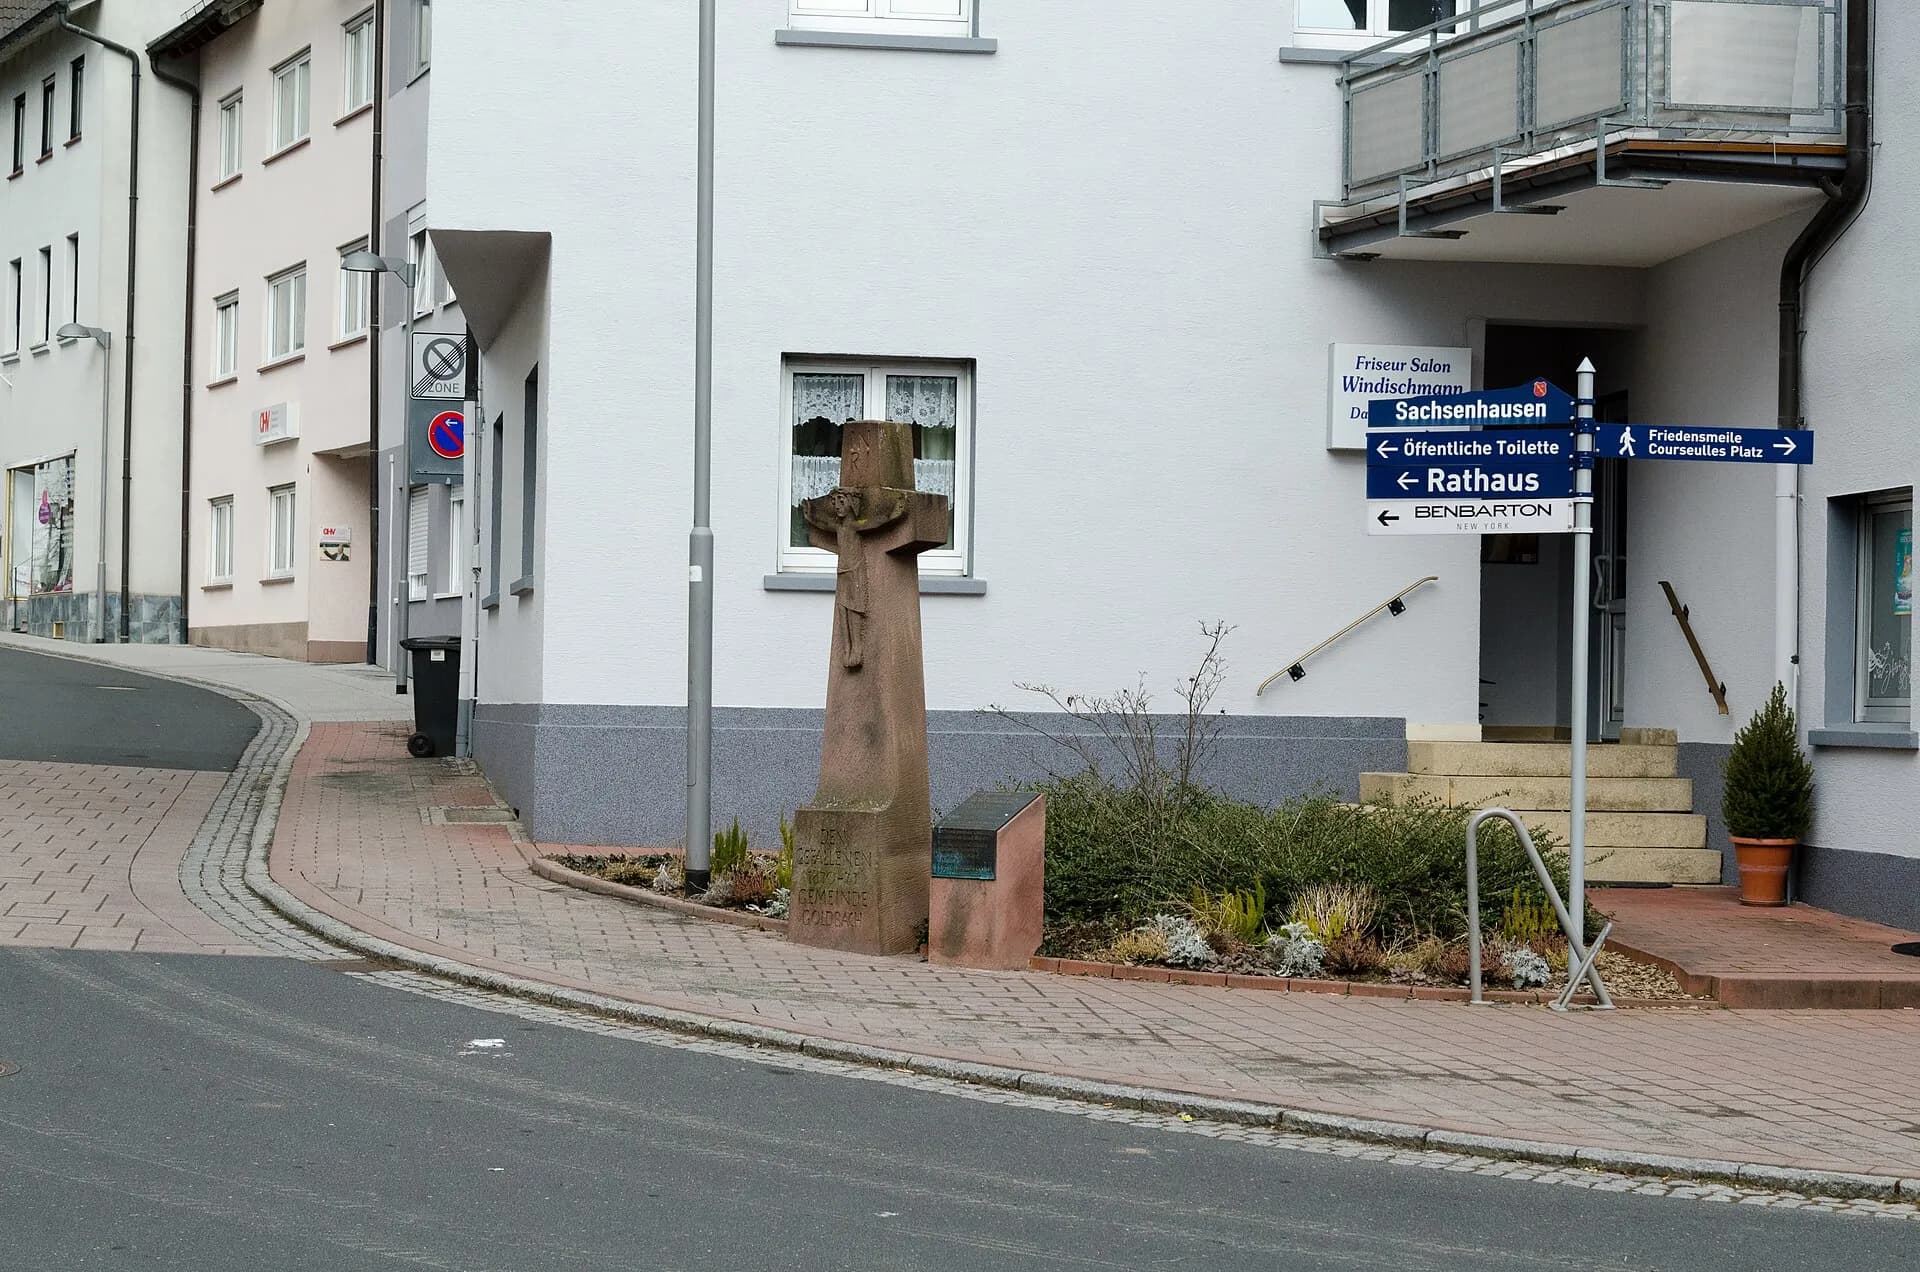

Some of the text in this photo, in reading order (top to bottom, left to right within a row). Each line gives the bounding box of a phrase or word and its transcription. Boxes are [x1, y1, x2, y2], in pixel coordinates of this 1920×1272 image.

[1355, 355, 1451, 373] Friseur Salon
[428, 382, 460, 394] ZONE
[1342, 375, 1463, 396] Windischmann
[1395, 400, 1547, 420] Sachsenhausen
[1649, 429, 1742, 443] Friedensmeile
[1404, 438, 1560, 456] Öffentliche Toilette
[1648, 444, 1763, 458] Courseulles Platz
[1427, 468, 1540, 492] Rathaus
[1414, 504, 1552, 519] BENBARTON
[1456, 522, 1510, 531] NEW YORK
[798, 888, 868, 908] GEMEINDE
